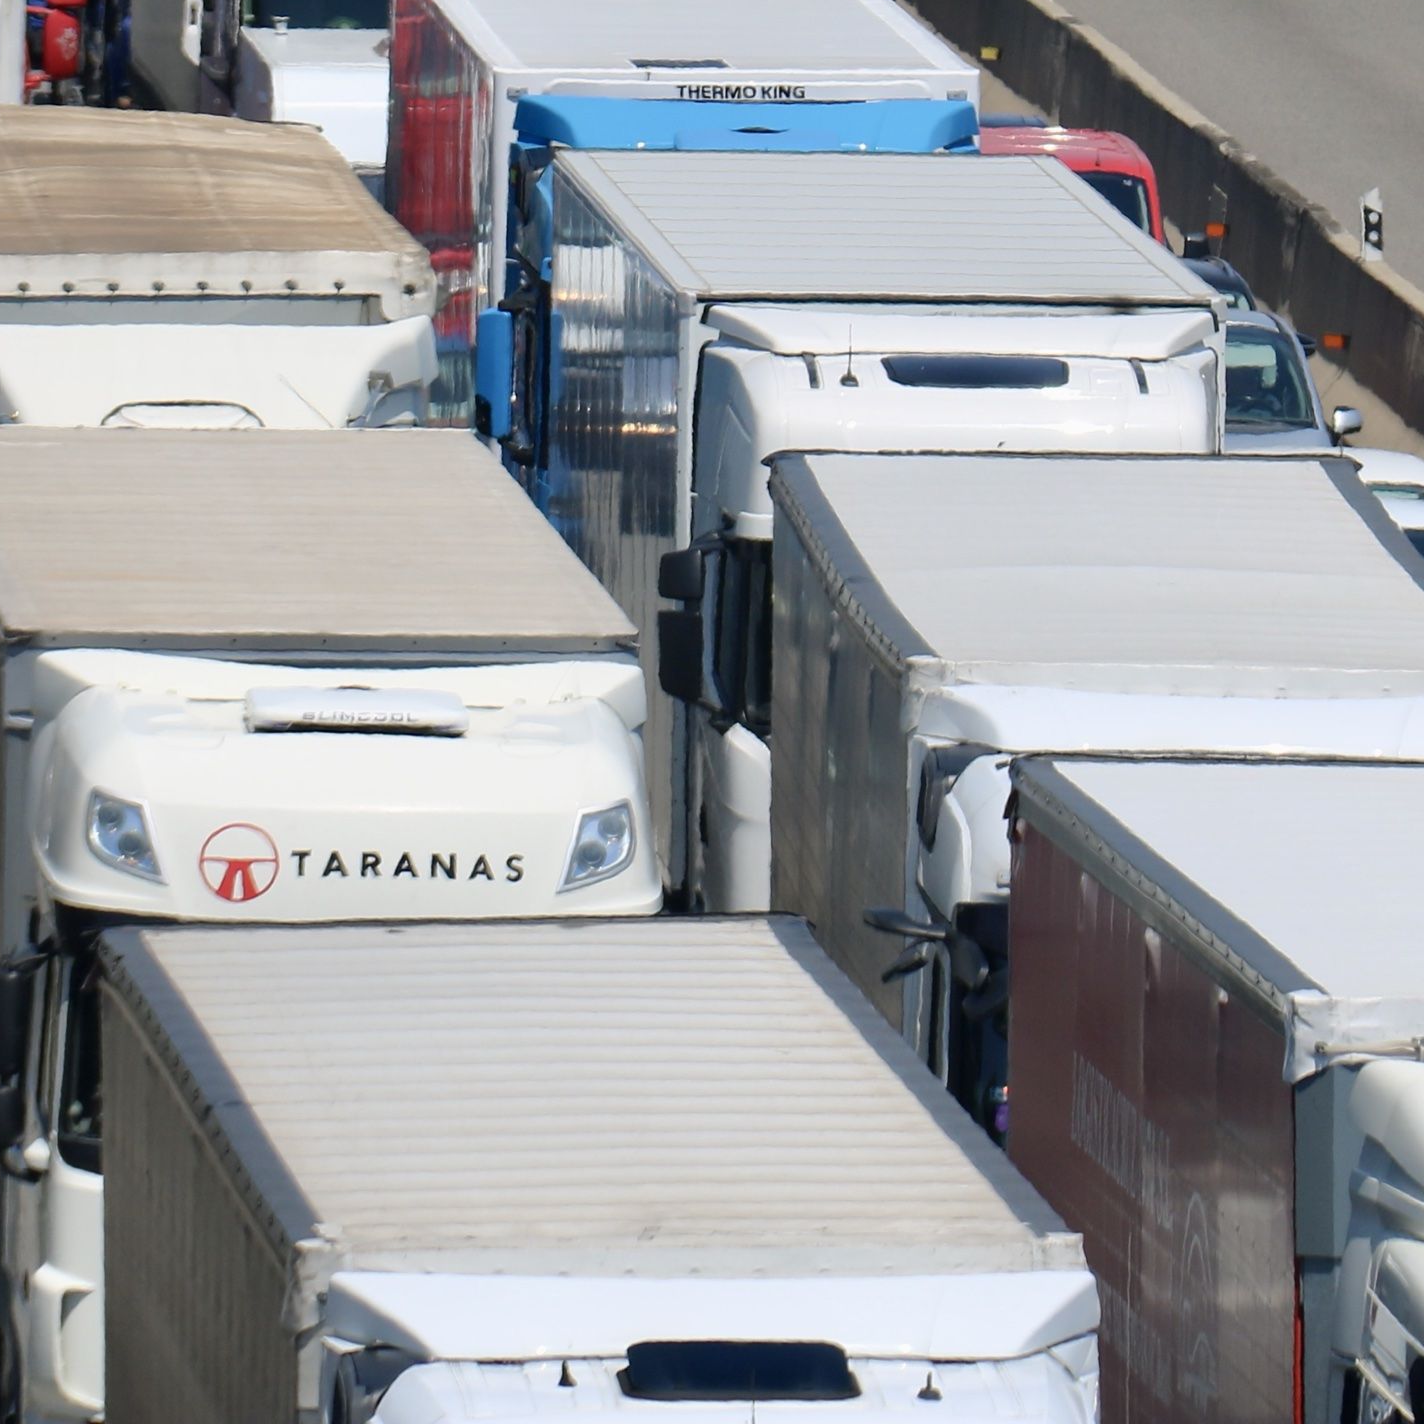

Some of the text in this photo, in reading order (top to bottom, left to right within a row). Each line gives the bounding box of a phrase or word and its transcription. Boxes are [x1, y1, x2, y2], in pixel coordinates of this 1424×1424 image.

[677, 85, 806, 99] THERMO KING
[302, 711, 419, 724] SLIMCOOL
[290, 849, 526, 883] TARANAS
